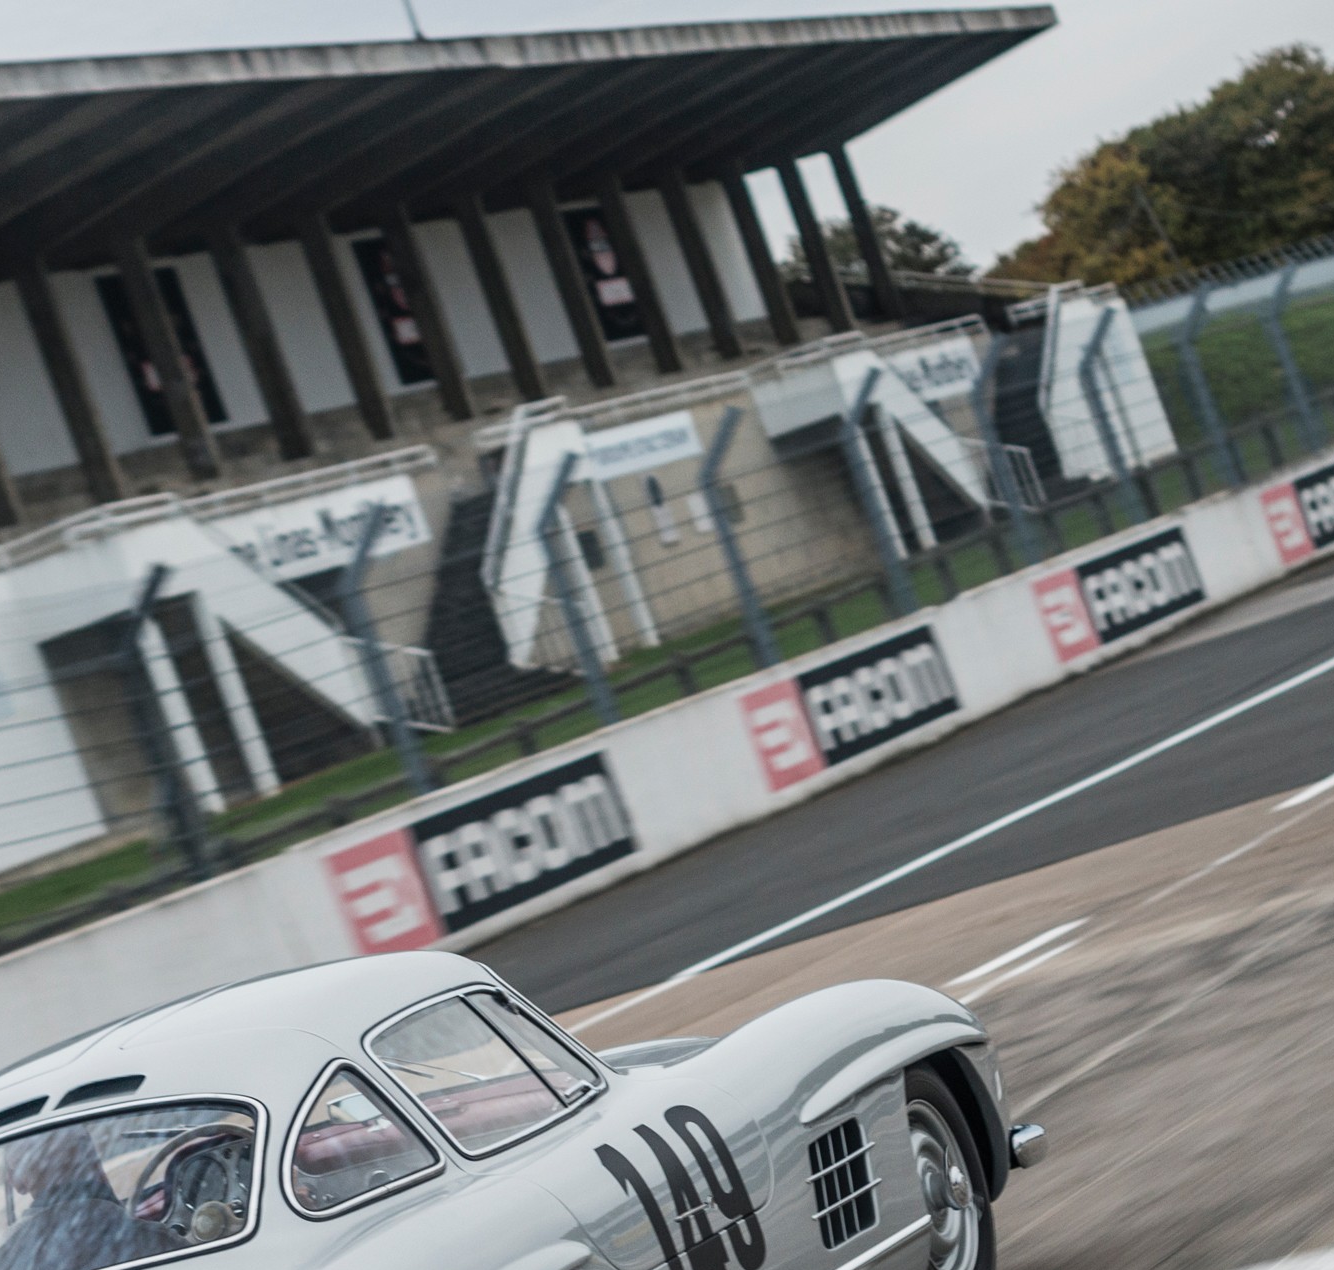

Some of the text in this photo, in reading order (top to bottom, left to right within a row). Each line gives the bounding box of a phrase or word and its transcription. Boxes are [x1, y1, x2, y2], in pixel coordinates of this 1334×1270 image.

[1083, 541, 1201, 631] FACOM
[805, 643, 955, 750] FACOM
[418, 773, 633, 915] FACOM
